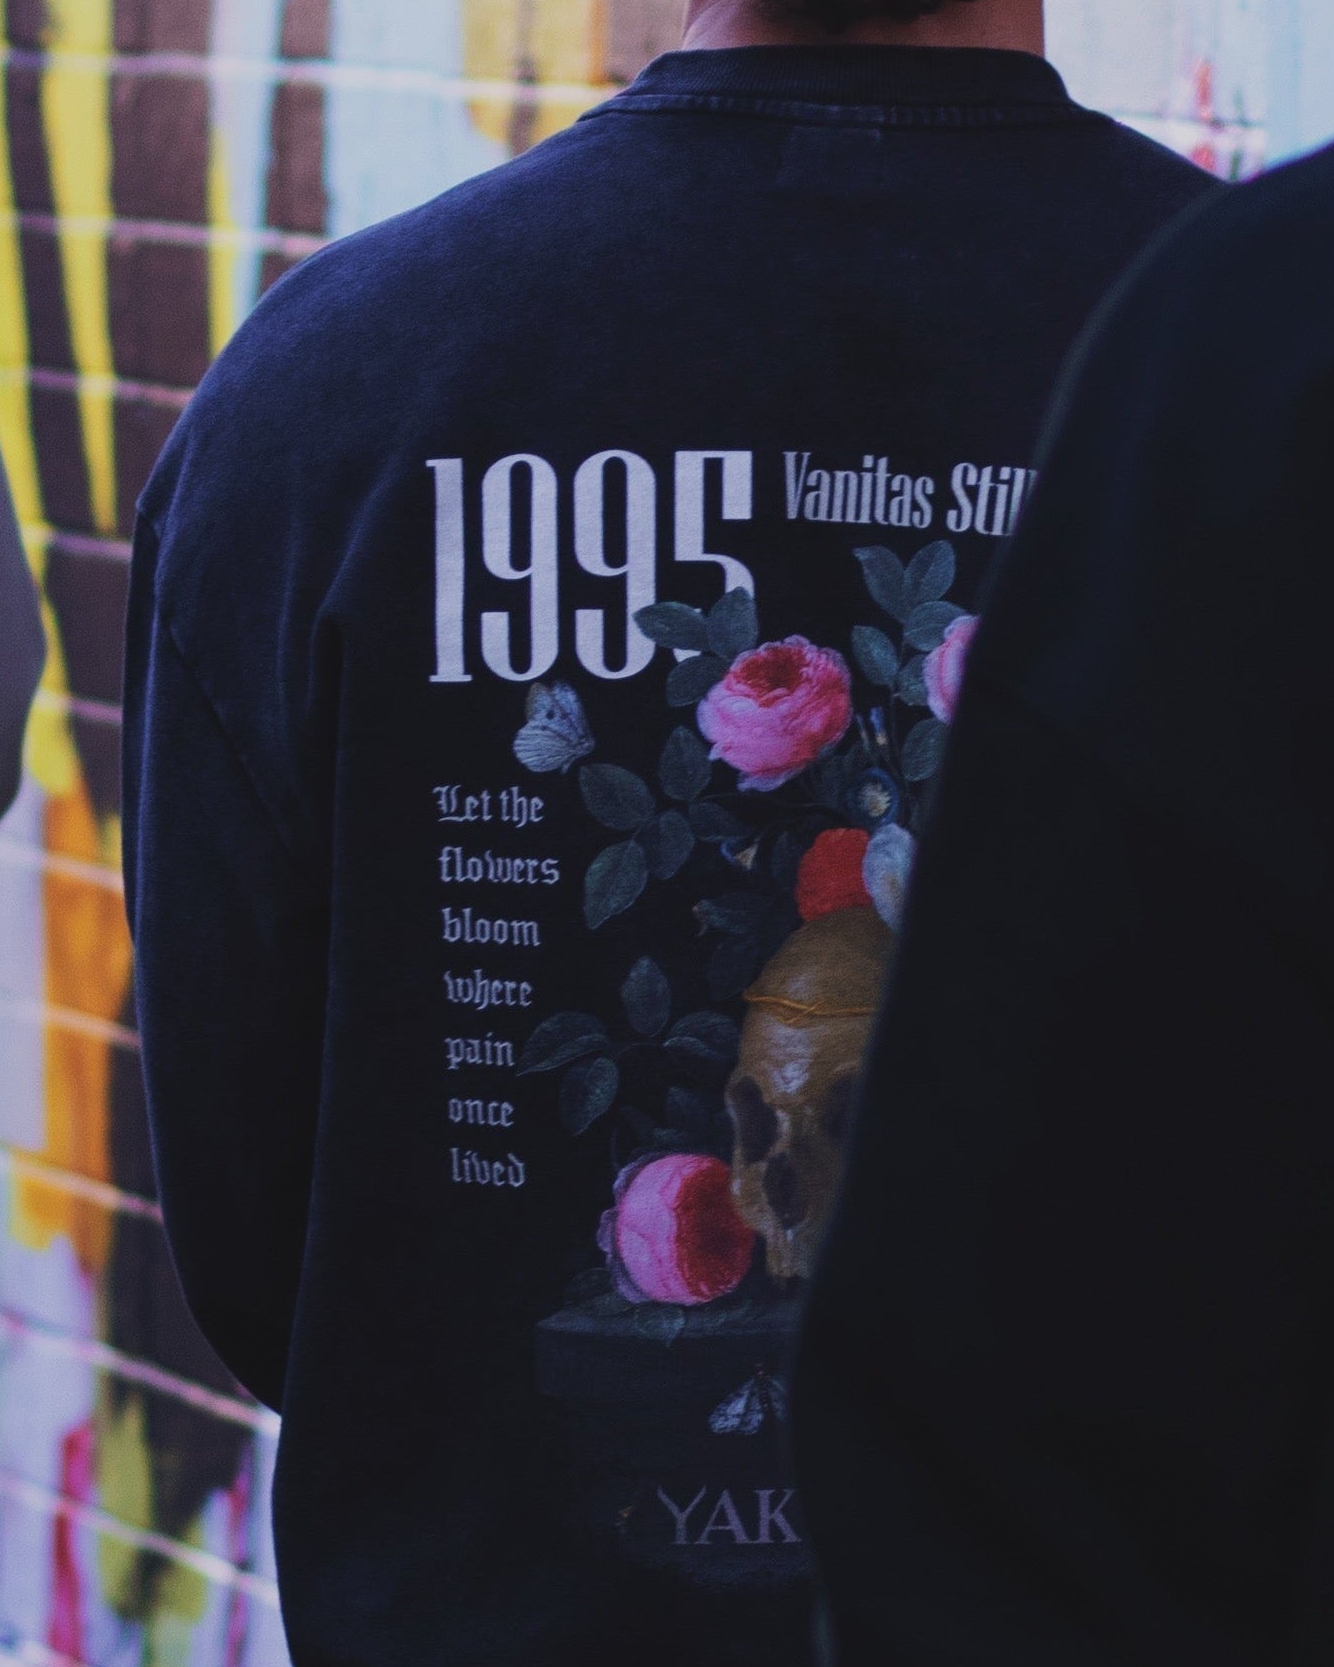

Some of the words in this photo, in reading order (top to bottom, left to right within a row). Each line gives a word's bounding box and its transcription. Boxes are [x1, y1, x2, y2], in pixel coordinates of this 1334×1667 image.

[425, 449, 755, 684] 1995
[783, 451, 935, 529] Vanitas
[433, 784, 492, 822] Let
[500, 786, 545, 828] the
[439, 845, 560, 885] flowers
[442, 907, 540, 947] bloom
[443, 968, 533, 1010] where
[444, 1032, 515, 1070] pain
[447, 1096, 514, 1127] once
[450, 1147, 526, 1188] lived
